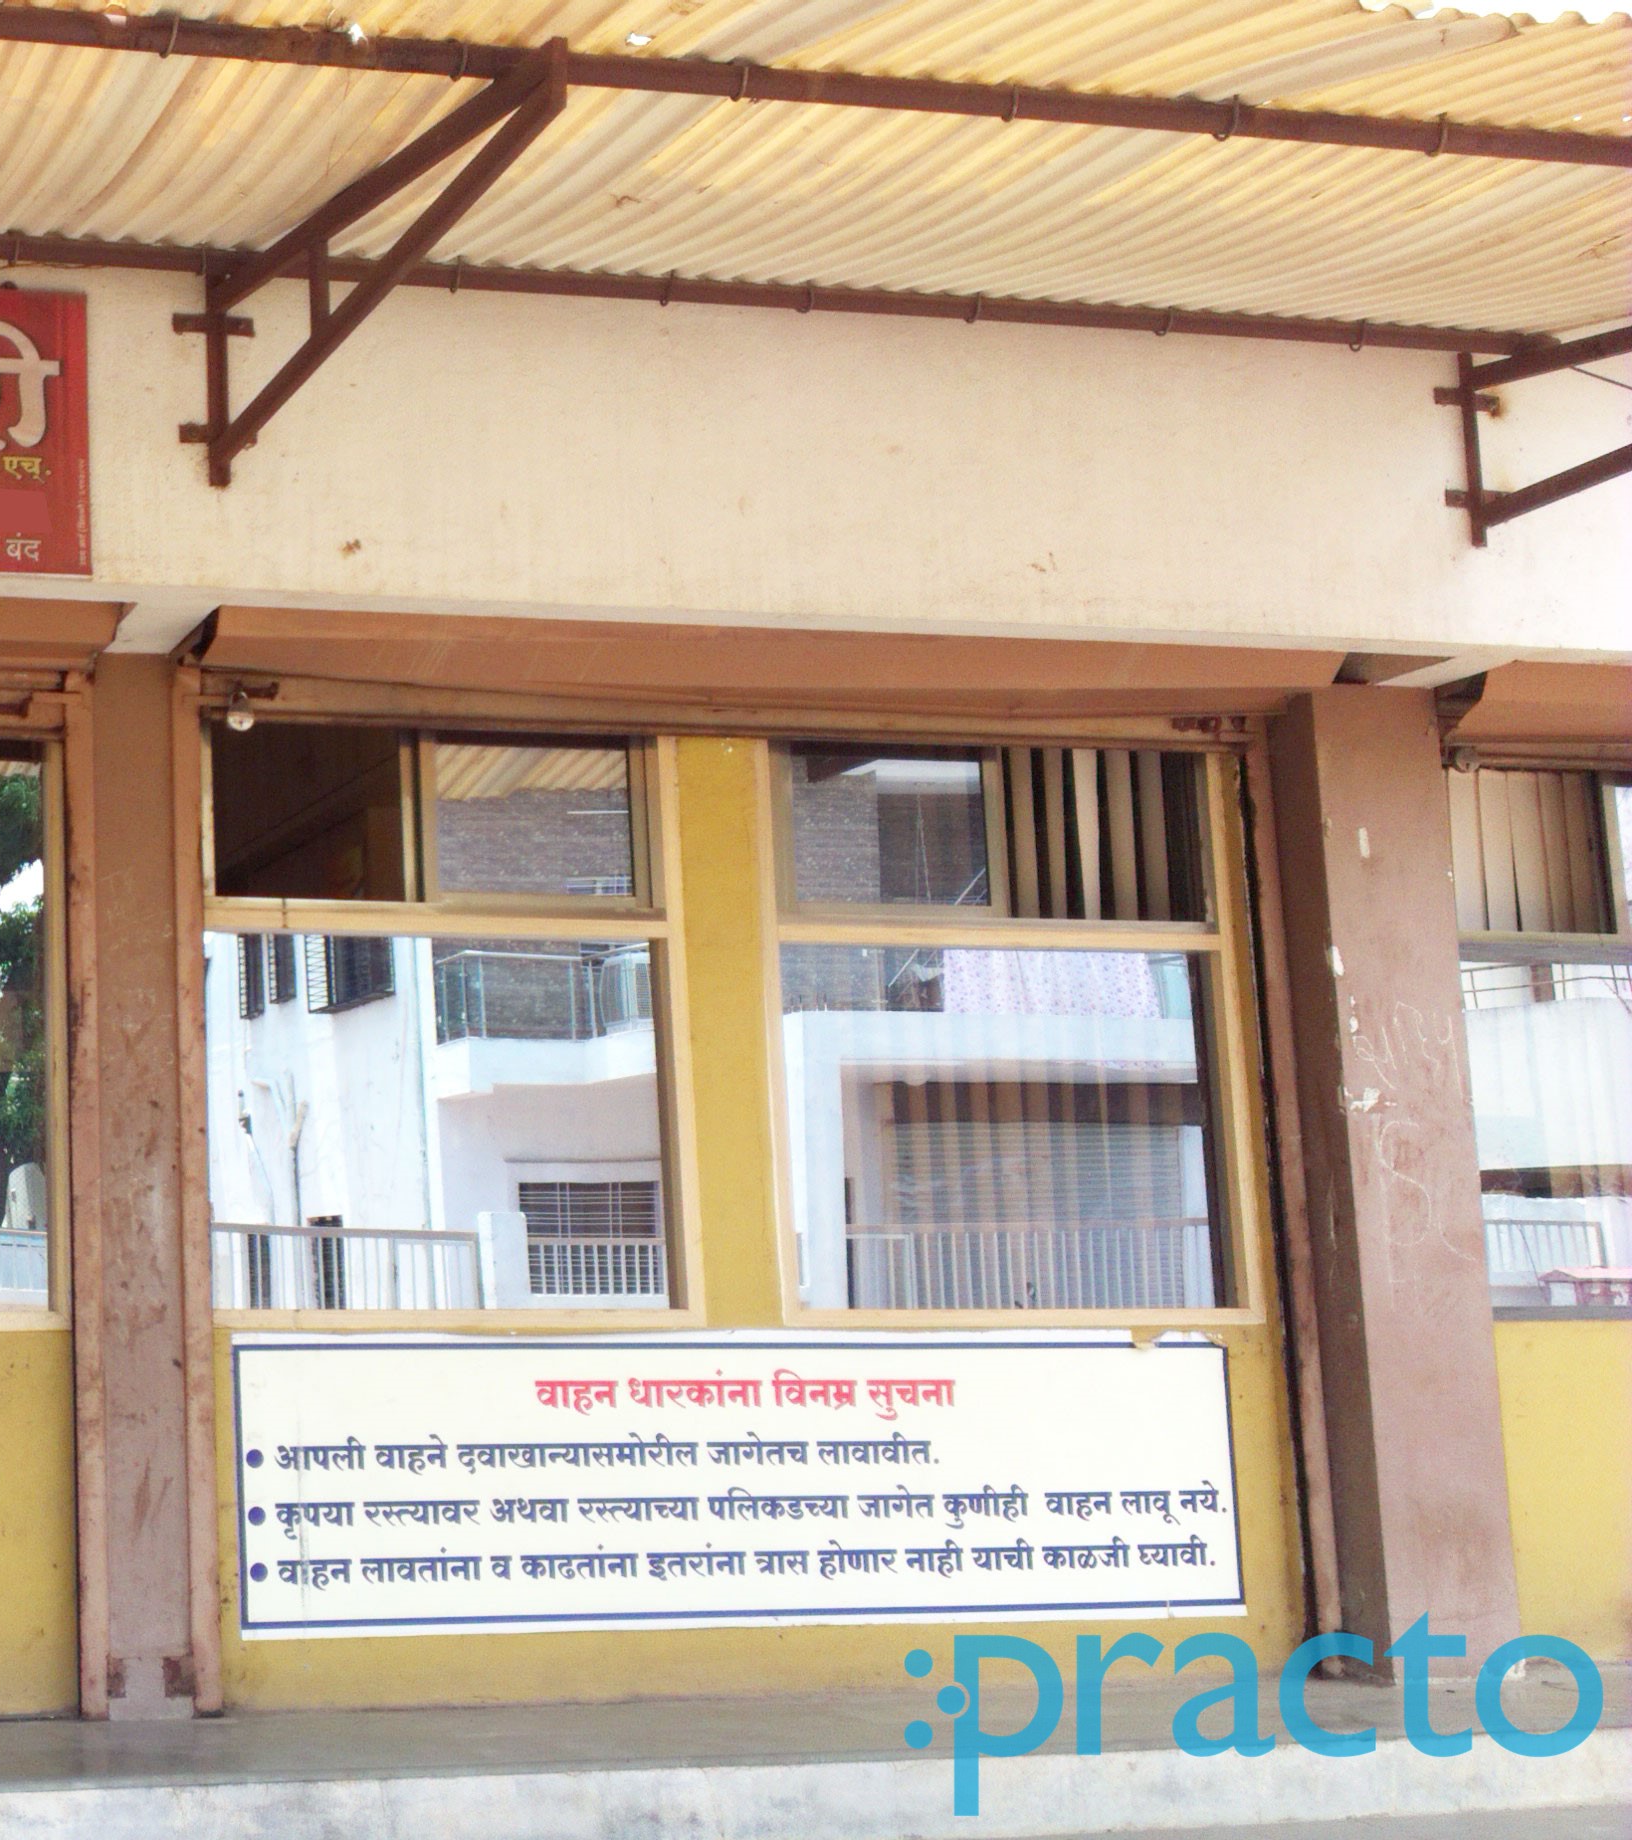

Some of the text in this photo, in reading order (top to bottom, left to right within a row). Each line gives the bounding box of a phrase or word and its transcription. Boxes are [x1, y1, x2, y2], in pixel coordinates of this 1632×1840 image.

[5, 532, 42, 562] बंद
[534, 1367, 956, 1421] वाहन धारकांना विनम्र सुचना
[274, 1430, 940, 1476] आपली वाहने दवाखान्यासमोरील जागेतच लावावीत.
[274, 1479, 1228, 1541] कृपया रस्त्यावर अथवा रस्त्याच्या पलिकडच्या जागेत कुणीही वाहन लावू नये.
[276, 1533, 1217, 1591] वाहन लावतांना व काढतांना इतरांना त्रास होणार नाही याची काळजी घ्यावी.
